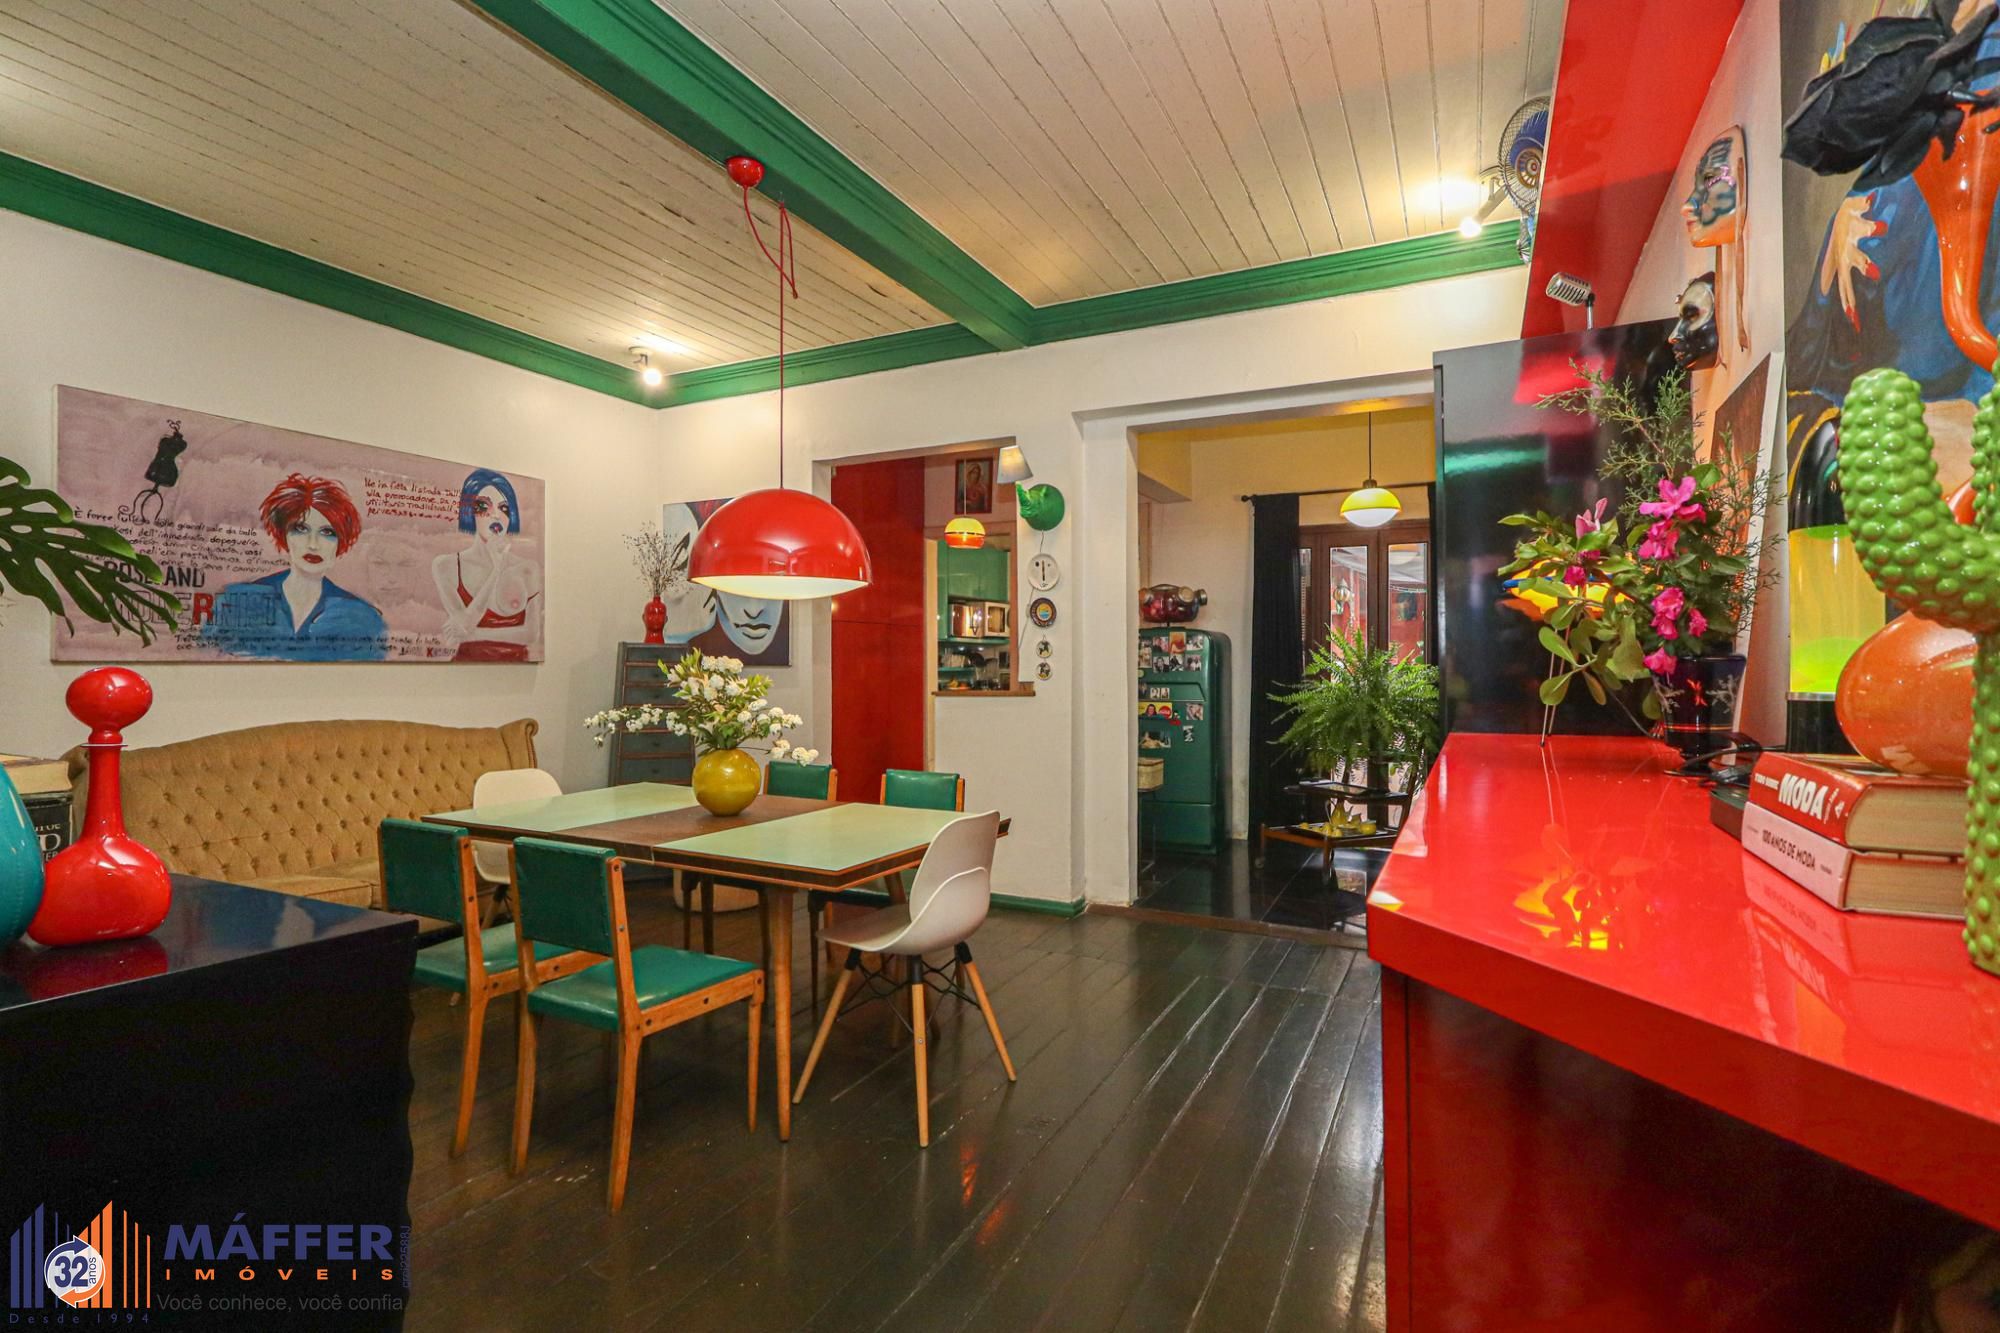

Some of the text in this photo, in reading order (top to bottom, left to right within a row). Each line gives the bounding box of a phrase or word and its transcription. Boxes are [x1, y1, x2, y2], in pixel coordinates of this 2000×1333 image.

[1778, 772, 1829, 821] MODA
[1771, 832, 1787, 854] ANOS
[1787, 842, 1796, 859] DE
[1796, 848, 1816, 871] MODA
